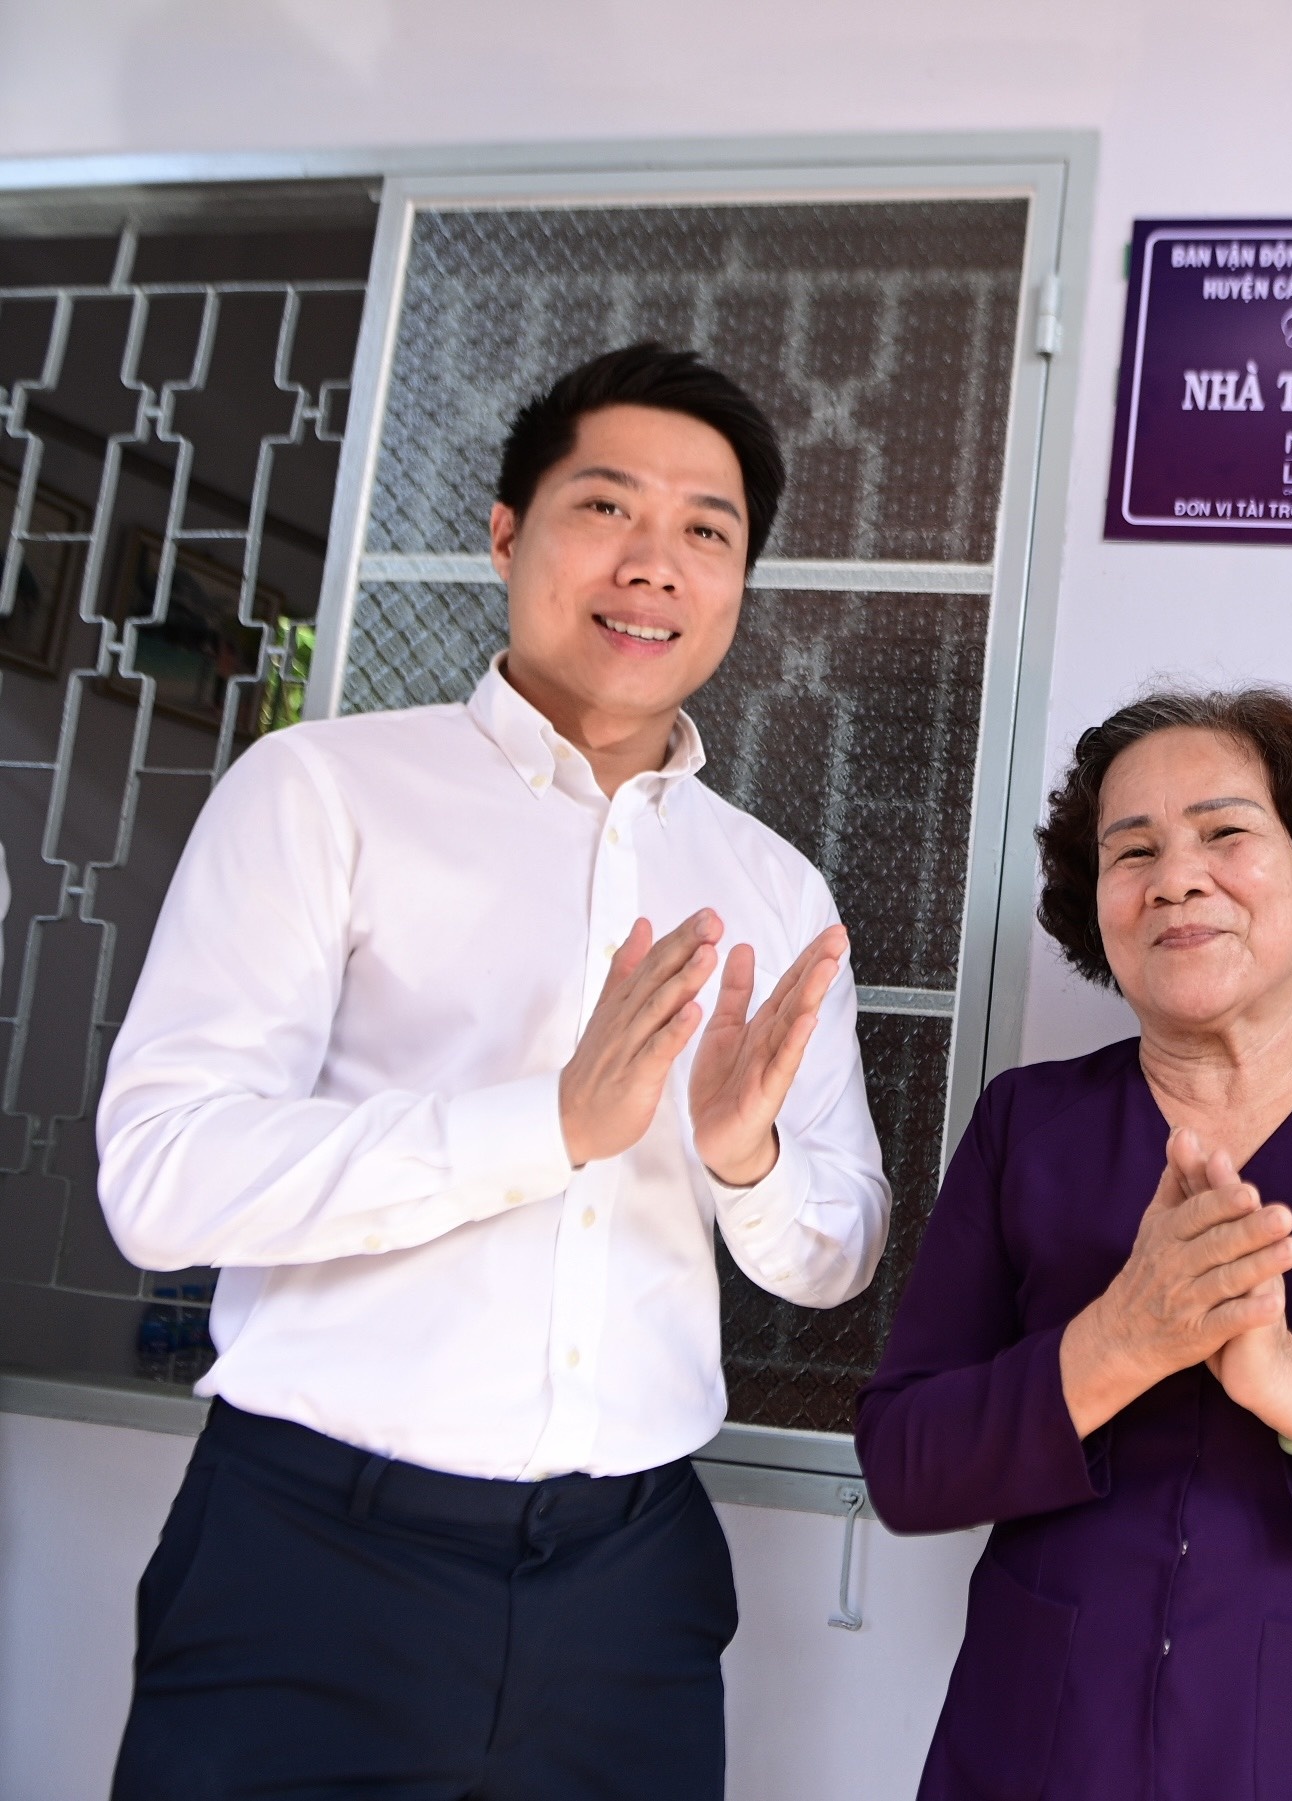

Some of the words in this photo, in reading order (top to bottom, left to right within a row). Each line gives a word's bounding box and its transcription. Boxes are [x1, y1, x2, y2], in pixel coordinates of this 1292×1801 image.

[1171, 243, 1212, 268] BAN
[1215, 241, 1255, 271] VẬN
[1203, 273, 1270, 303] HUYỆN
[1182, 360, 1264, 411] NHÀ
[1174, 499, 1211, 516] ĐƠN
[1215, 500, 1233, 520] VỊ
[1236, 499, 1264, 518] TÀI
